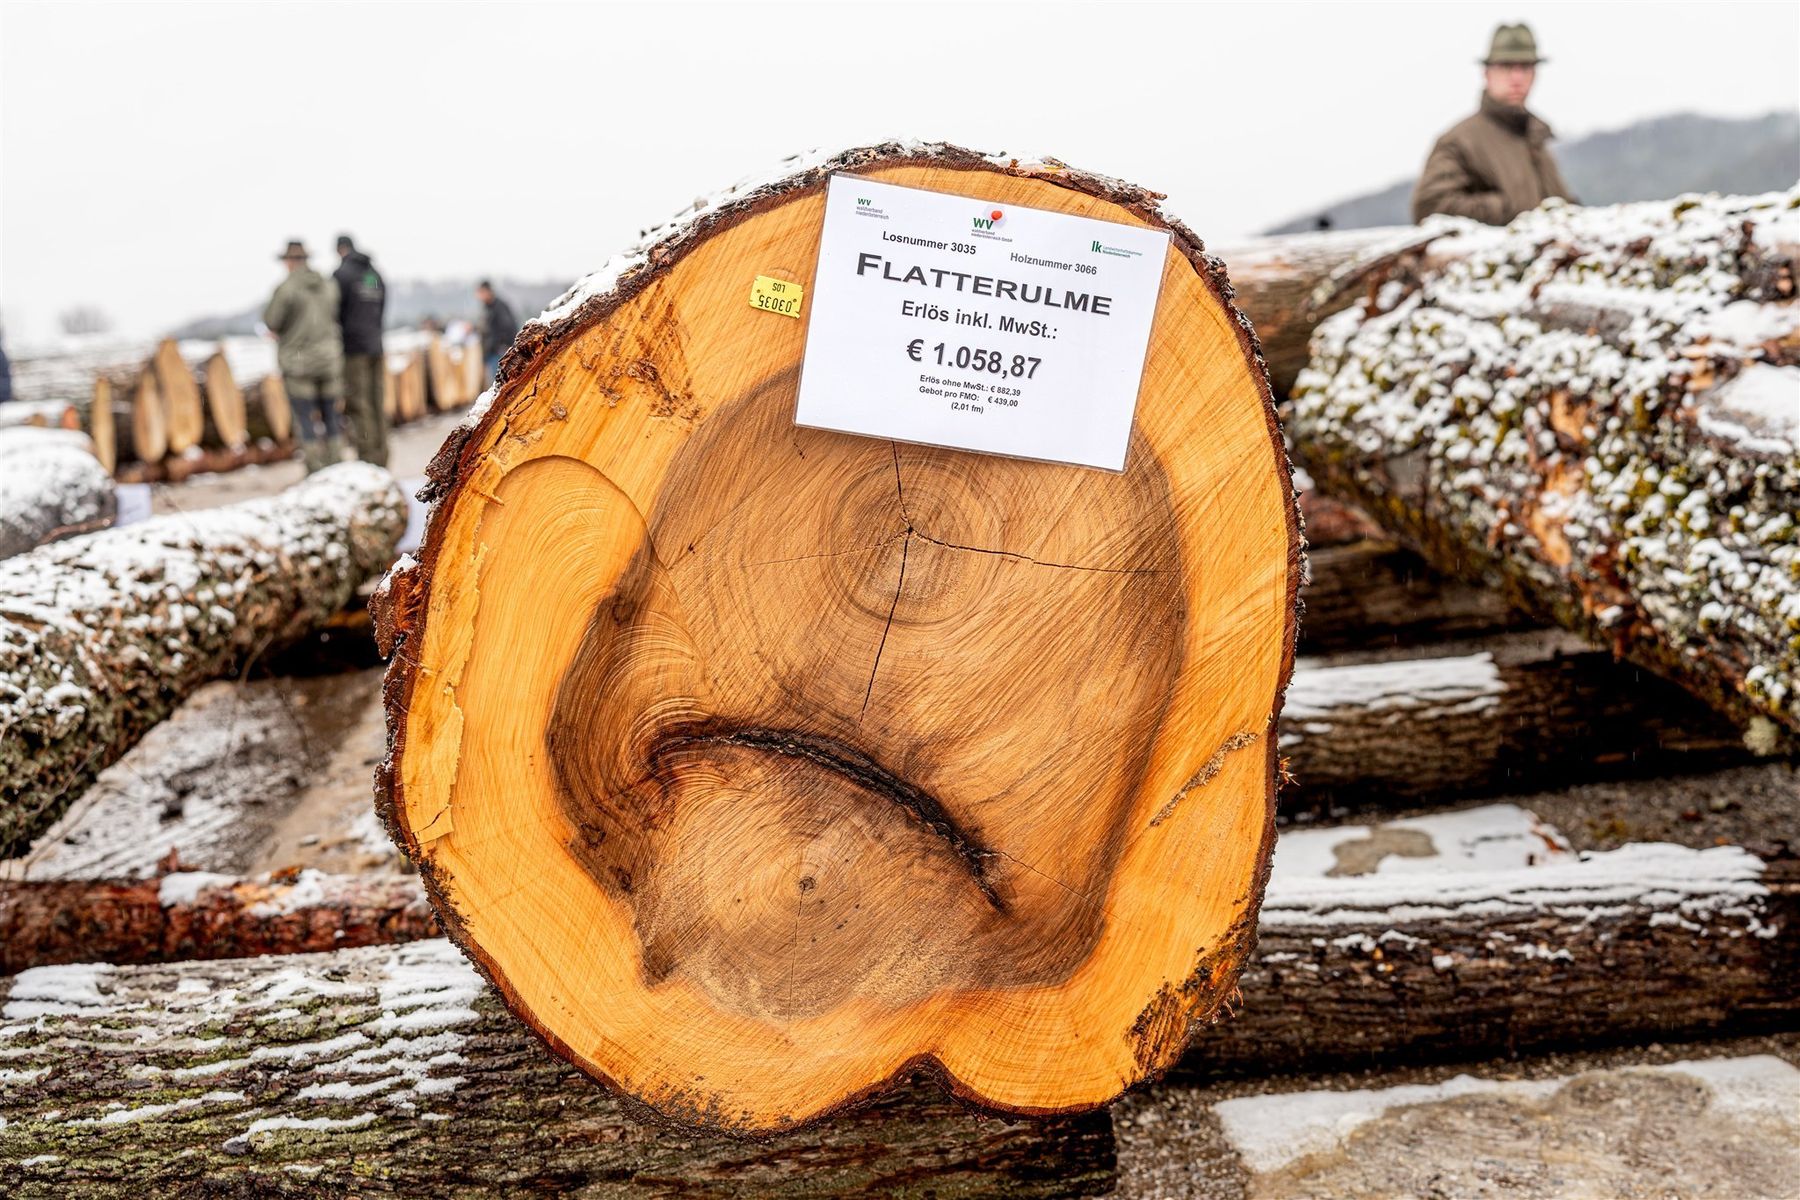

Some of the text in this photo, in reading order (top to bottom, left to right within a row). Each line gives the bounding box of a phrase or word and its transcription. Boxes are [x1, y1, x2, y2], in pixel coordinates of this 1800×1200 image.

[882, 230, 977, 255] Losnummer 3035
[1010, 252, 1098, 275] Holznummer 3066
[772, 282, 786, 293] LOS
[856, 252, 1112, 316] FLATTERULME
[758, 294, 793, 313] 03035
[901, 300, 1058, 339] Erlös inkl. MwSt.:
[906, 338, 1042, 379] € 1.058,87
[919, 374, 1021, 396] Erlös ohne MwSt.: € 882,39
[919, 385, 943, 396] Gebot
[944, 390, 957, 398] pro
[959, 392, 980, 402] FMO:
[994, 397, 1018, 407] 439,00
[951, 401, 984, 414] (2,01 fm)
